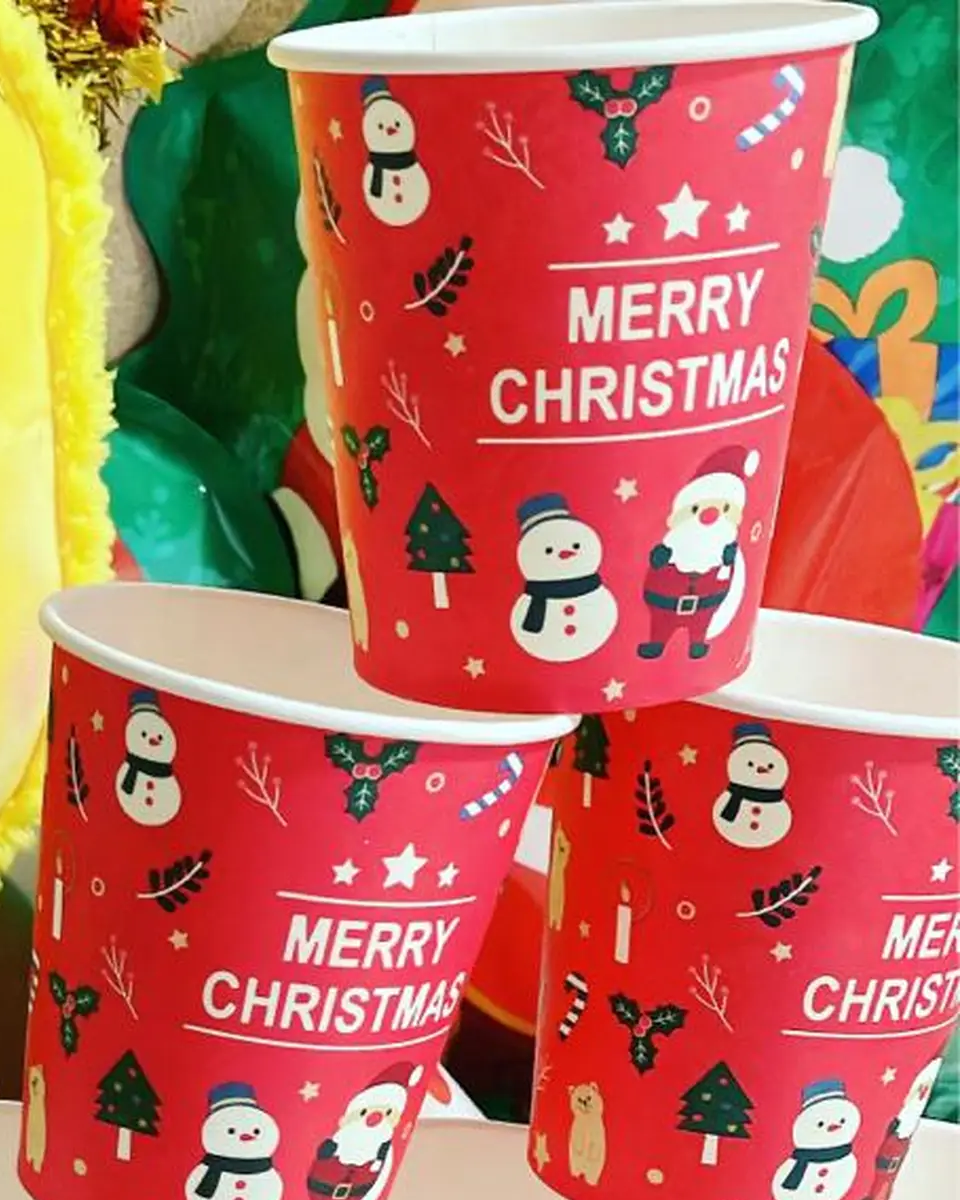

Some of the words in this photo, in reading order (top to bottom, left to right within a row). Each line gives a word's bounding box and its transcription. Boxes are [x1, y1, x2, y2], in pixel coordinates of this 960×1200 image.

[567, 267, 765, 345] MERRY
[489, 337, 790, 425] CHRISTMAS
[282, 913, 461, 970] MERRY
[201, 969, 467, 1034] CHRISTMAS
